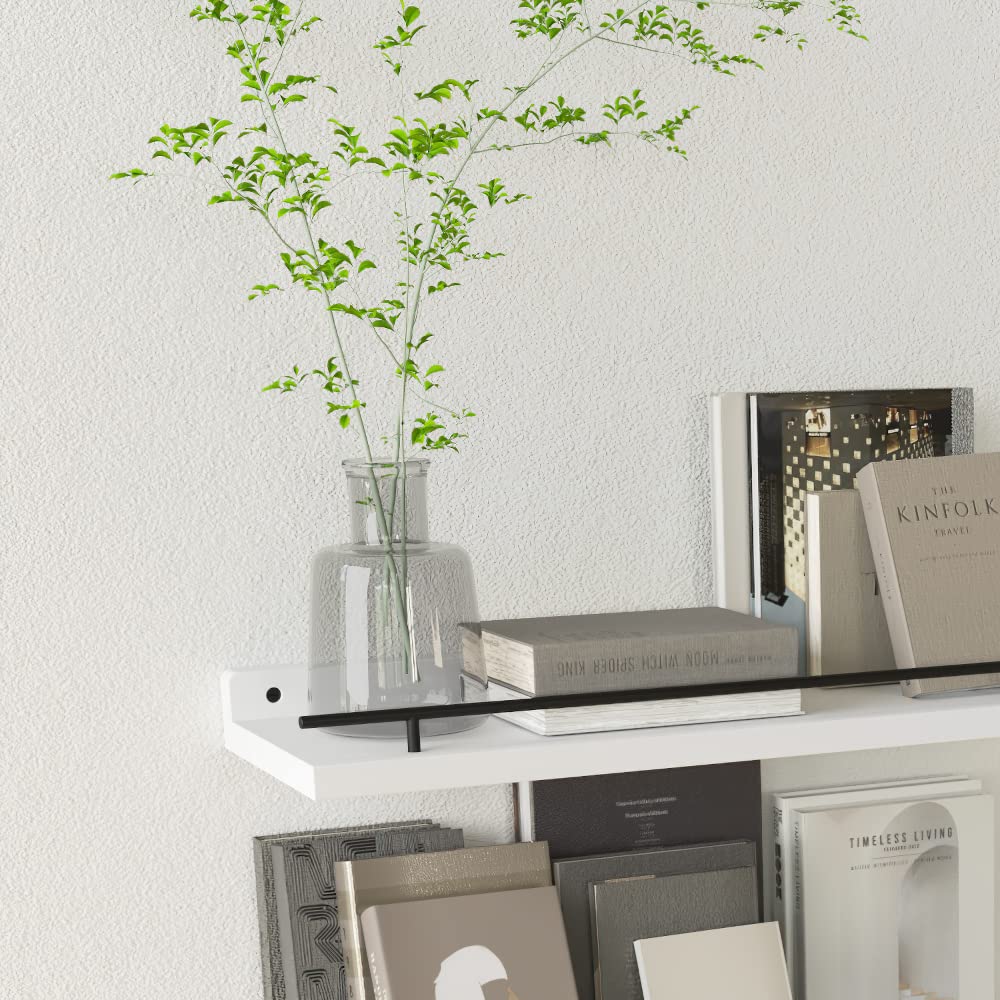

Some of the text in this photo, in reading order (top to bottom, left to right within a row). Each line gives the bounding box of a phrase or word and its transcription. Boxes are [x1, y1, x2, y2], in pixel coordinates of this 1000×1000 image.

[897, 498, 999, 523] KINFOLK
[934, 526, 970, 537] TRAVEL
[593, 657, 635, 675] SPIDER
[641, 654, 679, 672] WITCH
[685, 650, 719, 667] MOON
[557, 660, 586, 677] KING
[849, 832, 907, 848] TIMELESS
[913, 826, 953, 842] LIVING
